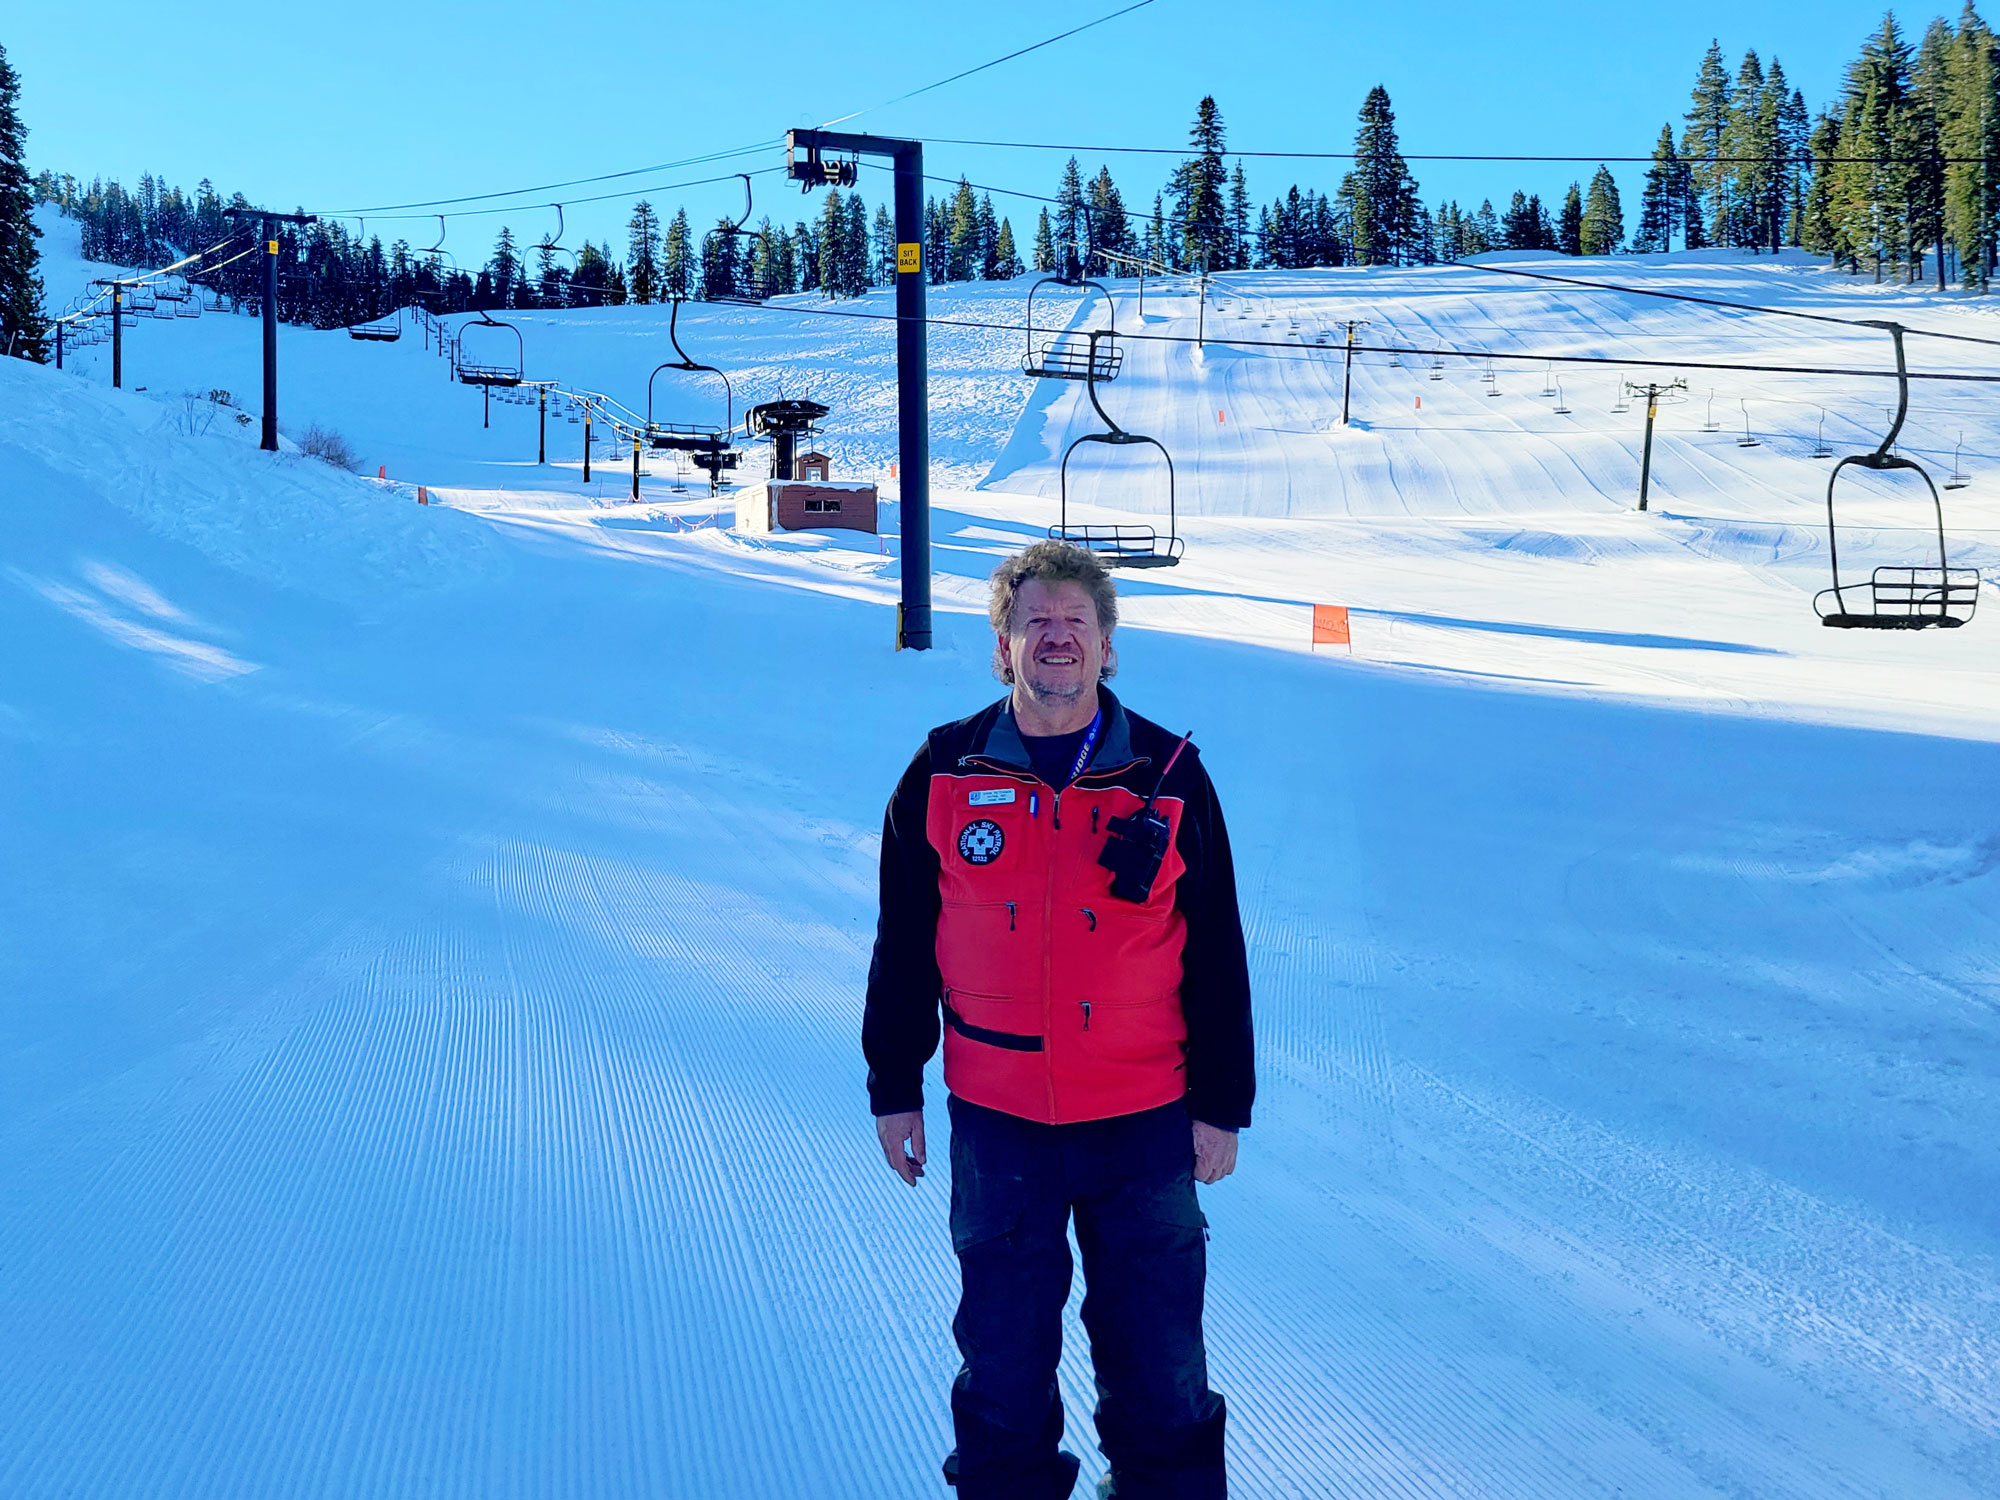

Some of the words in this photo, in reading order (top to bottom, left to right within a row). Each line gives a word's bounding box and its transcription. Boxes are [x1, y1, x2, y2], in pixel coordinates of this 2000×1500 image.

[853, 152, 858, 162] 2
[903, 250, 914, 258] SIT
[899, 258, 918, 266] BACK
[960, 823, 980, 857] NATIONAL
[981, 821, 995, 831] SKI
[989, 829, 1003, 856] PATROL
